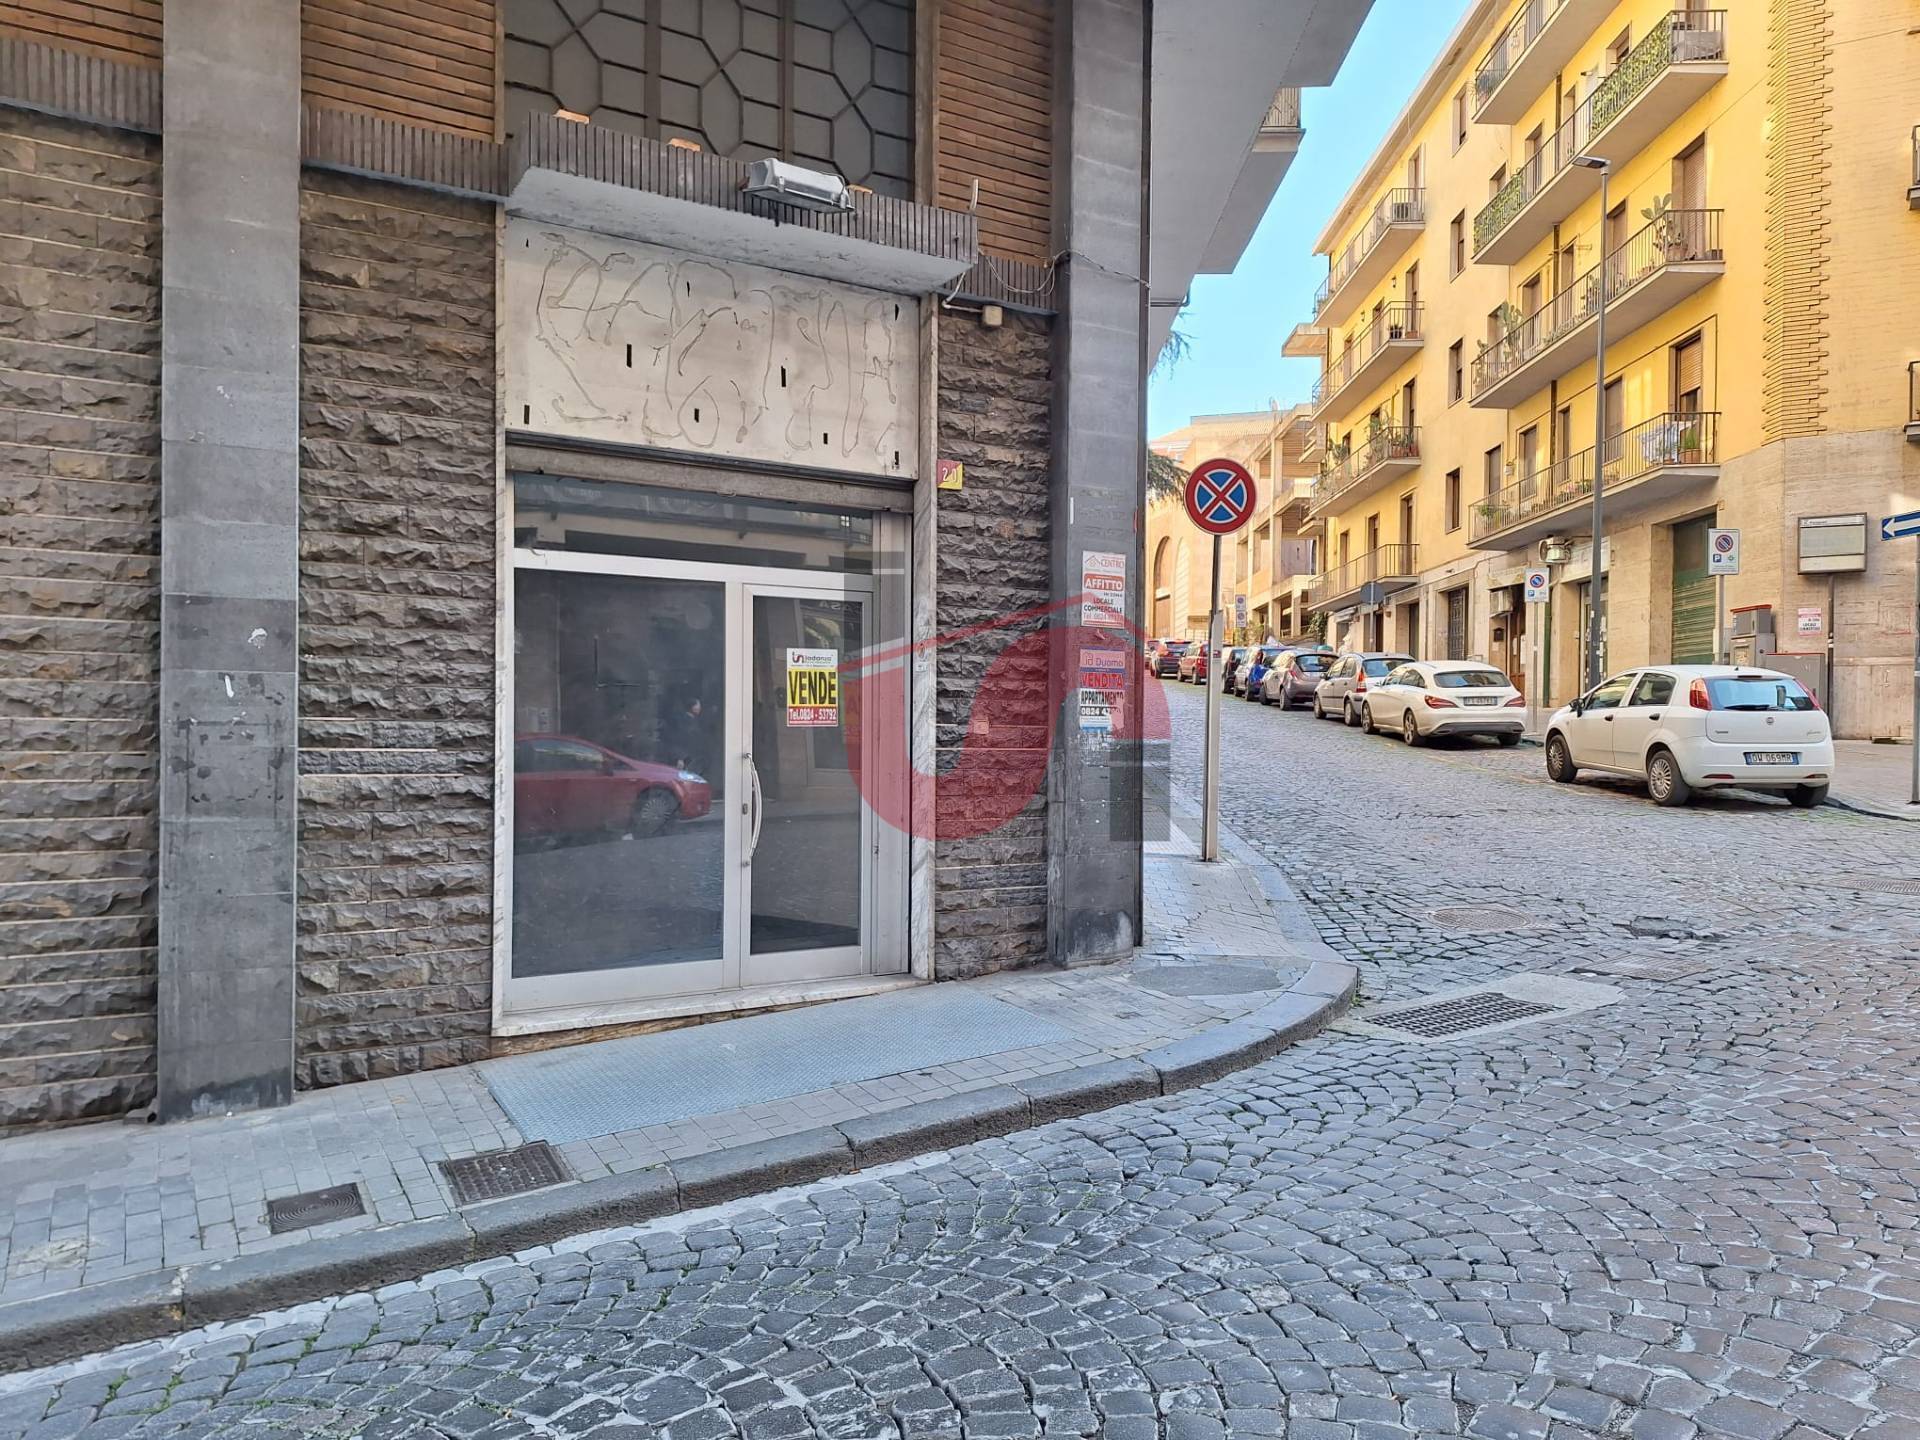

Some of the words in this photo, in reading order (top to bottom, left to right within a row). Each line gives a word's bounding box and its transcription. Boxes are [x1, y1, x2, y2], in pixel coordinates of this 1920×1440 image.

[942, 467, 956, 481] 20
[1101, 559, 1124, 569] CENTRO
[1085, 577, 1123, 591] AFFITTO
[1093, 597, 1114, 605] LOCALE
[1083, 604, 1122, 614] COMMERCIALE
[1096, 656, 1124, 667] Duomo
[1082, 672, 1124, 689] VENDITA
[788, 671, 837, 705] VENDE
[819, 708, 837, 721] 53792
[1081, 707, 1100, 715] 0824
[1765, 753, 1792, 763] 069MR
